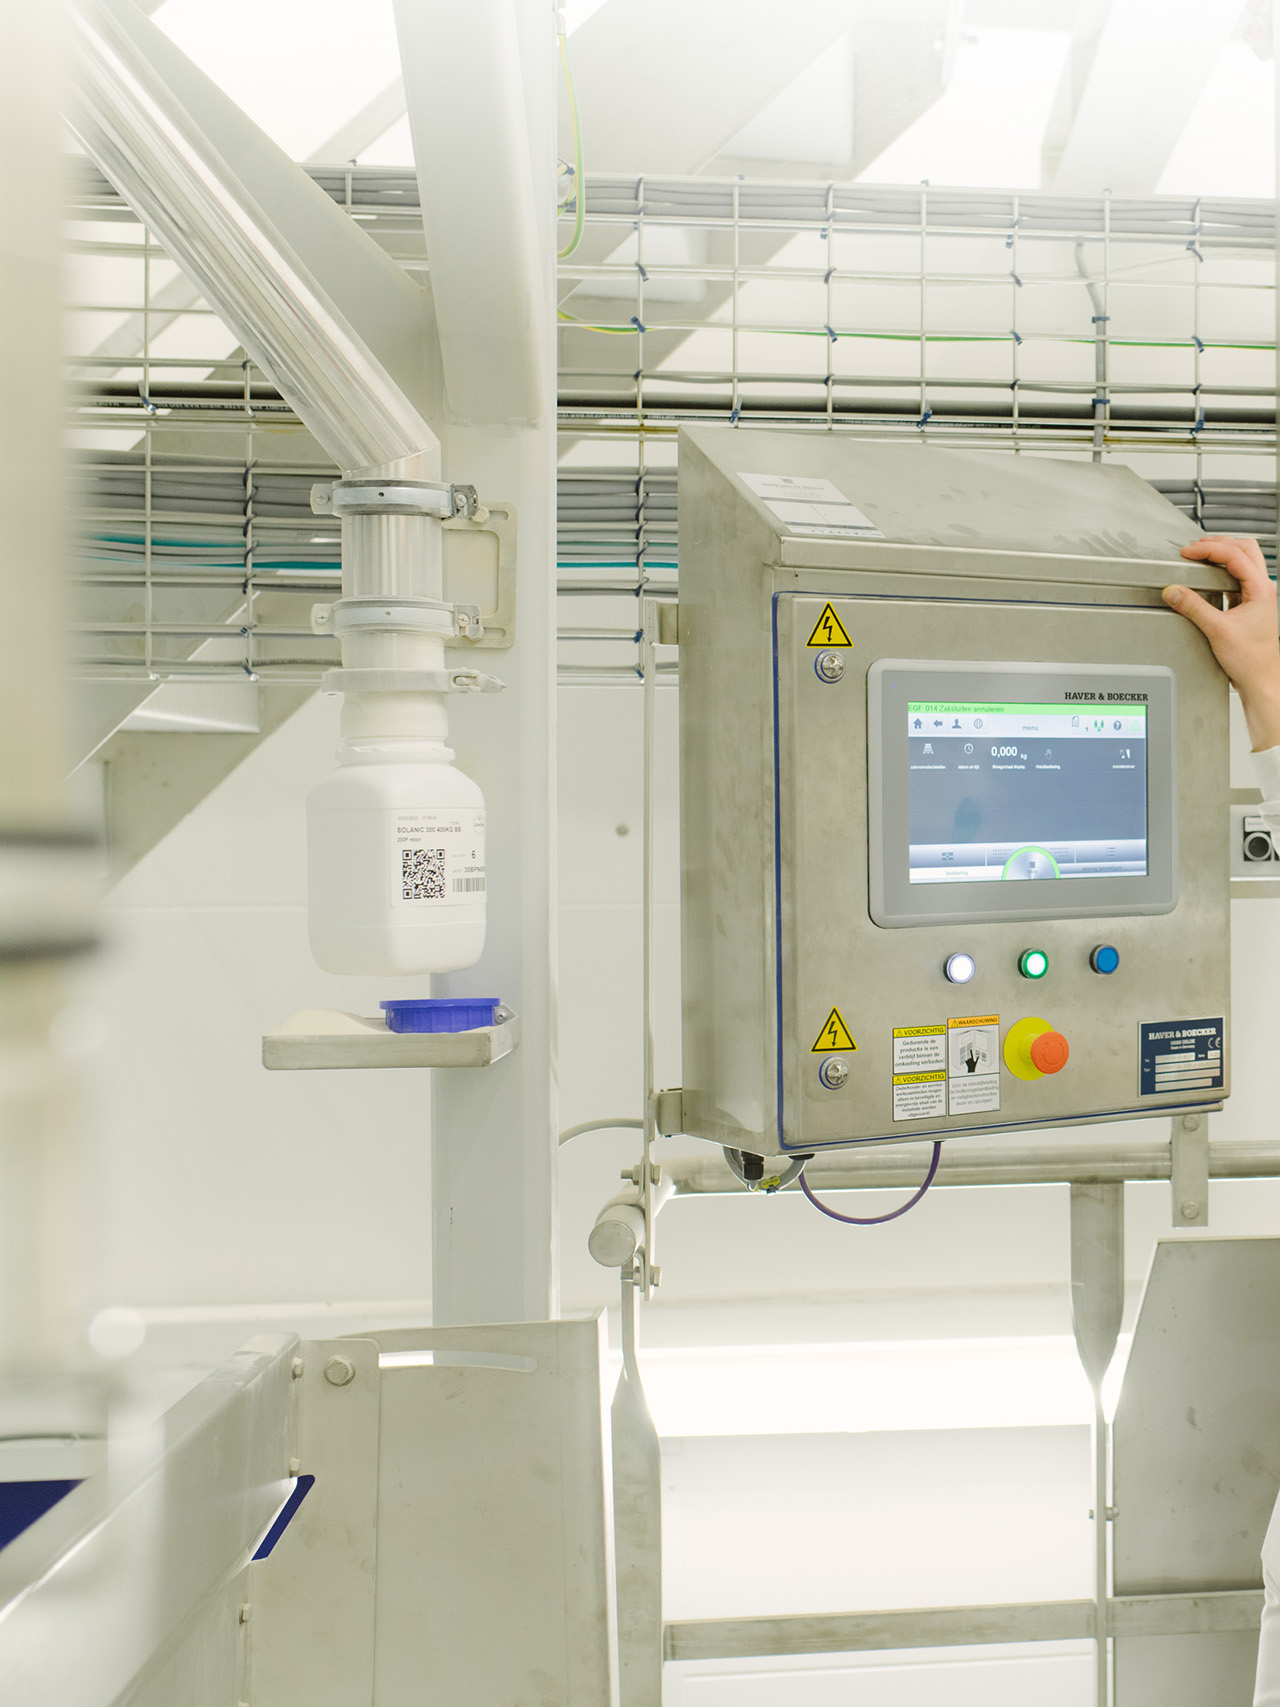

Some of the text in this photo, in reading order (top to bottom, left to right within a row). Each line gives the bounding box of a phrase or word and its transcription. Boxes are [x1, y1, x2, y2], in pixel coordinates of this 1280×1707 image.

[1065, 692, 1096, 700] HAVER
[1107, 693, 1148, 701] BOECKER
[991, 747, 1017, 758] 0,000
[472, 850, 476, 859] 6
[904, 1027, 944, 1035] VOORZICHTIG
[1149, 1032, 1174, 1040] HAVER
[1182, 1028, 1216, 1036] BOECKER
[903, 1074, 944, 1082] VOORZICHTIG
